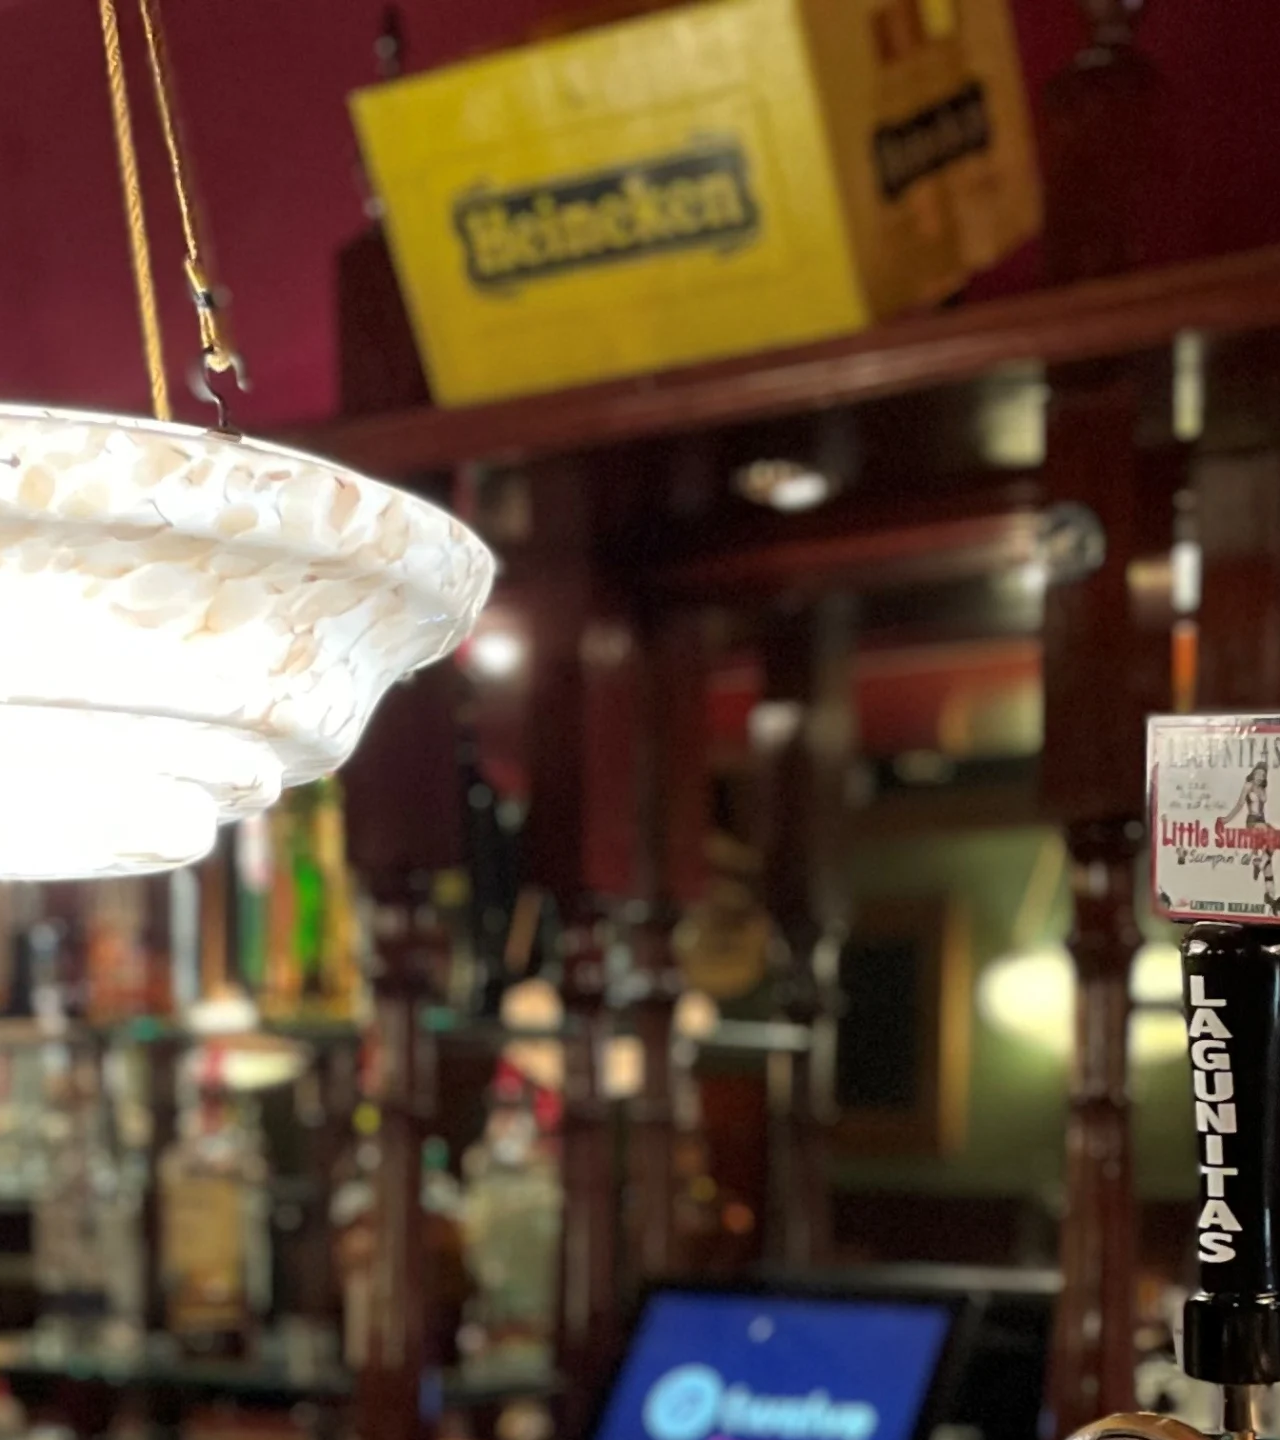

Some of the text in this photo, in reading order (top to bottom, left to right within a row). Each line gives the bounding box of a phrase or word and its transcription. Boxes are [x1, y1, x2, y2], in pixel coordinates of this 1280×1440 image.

[465, 170, 743, 277] Heineken
[1162, 815, 1209, 848] Little
[1190, 975, 1242, 1262] LAGUNITAS
